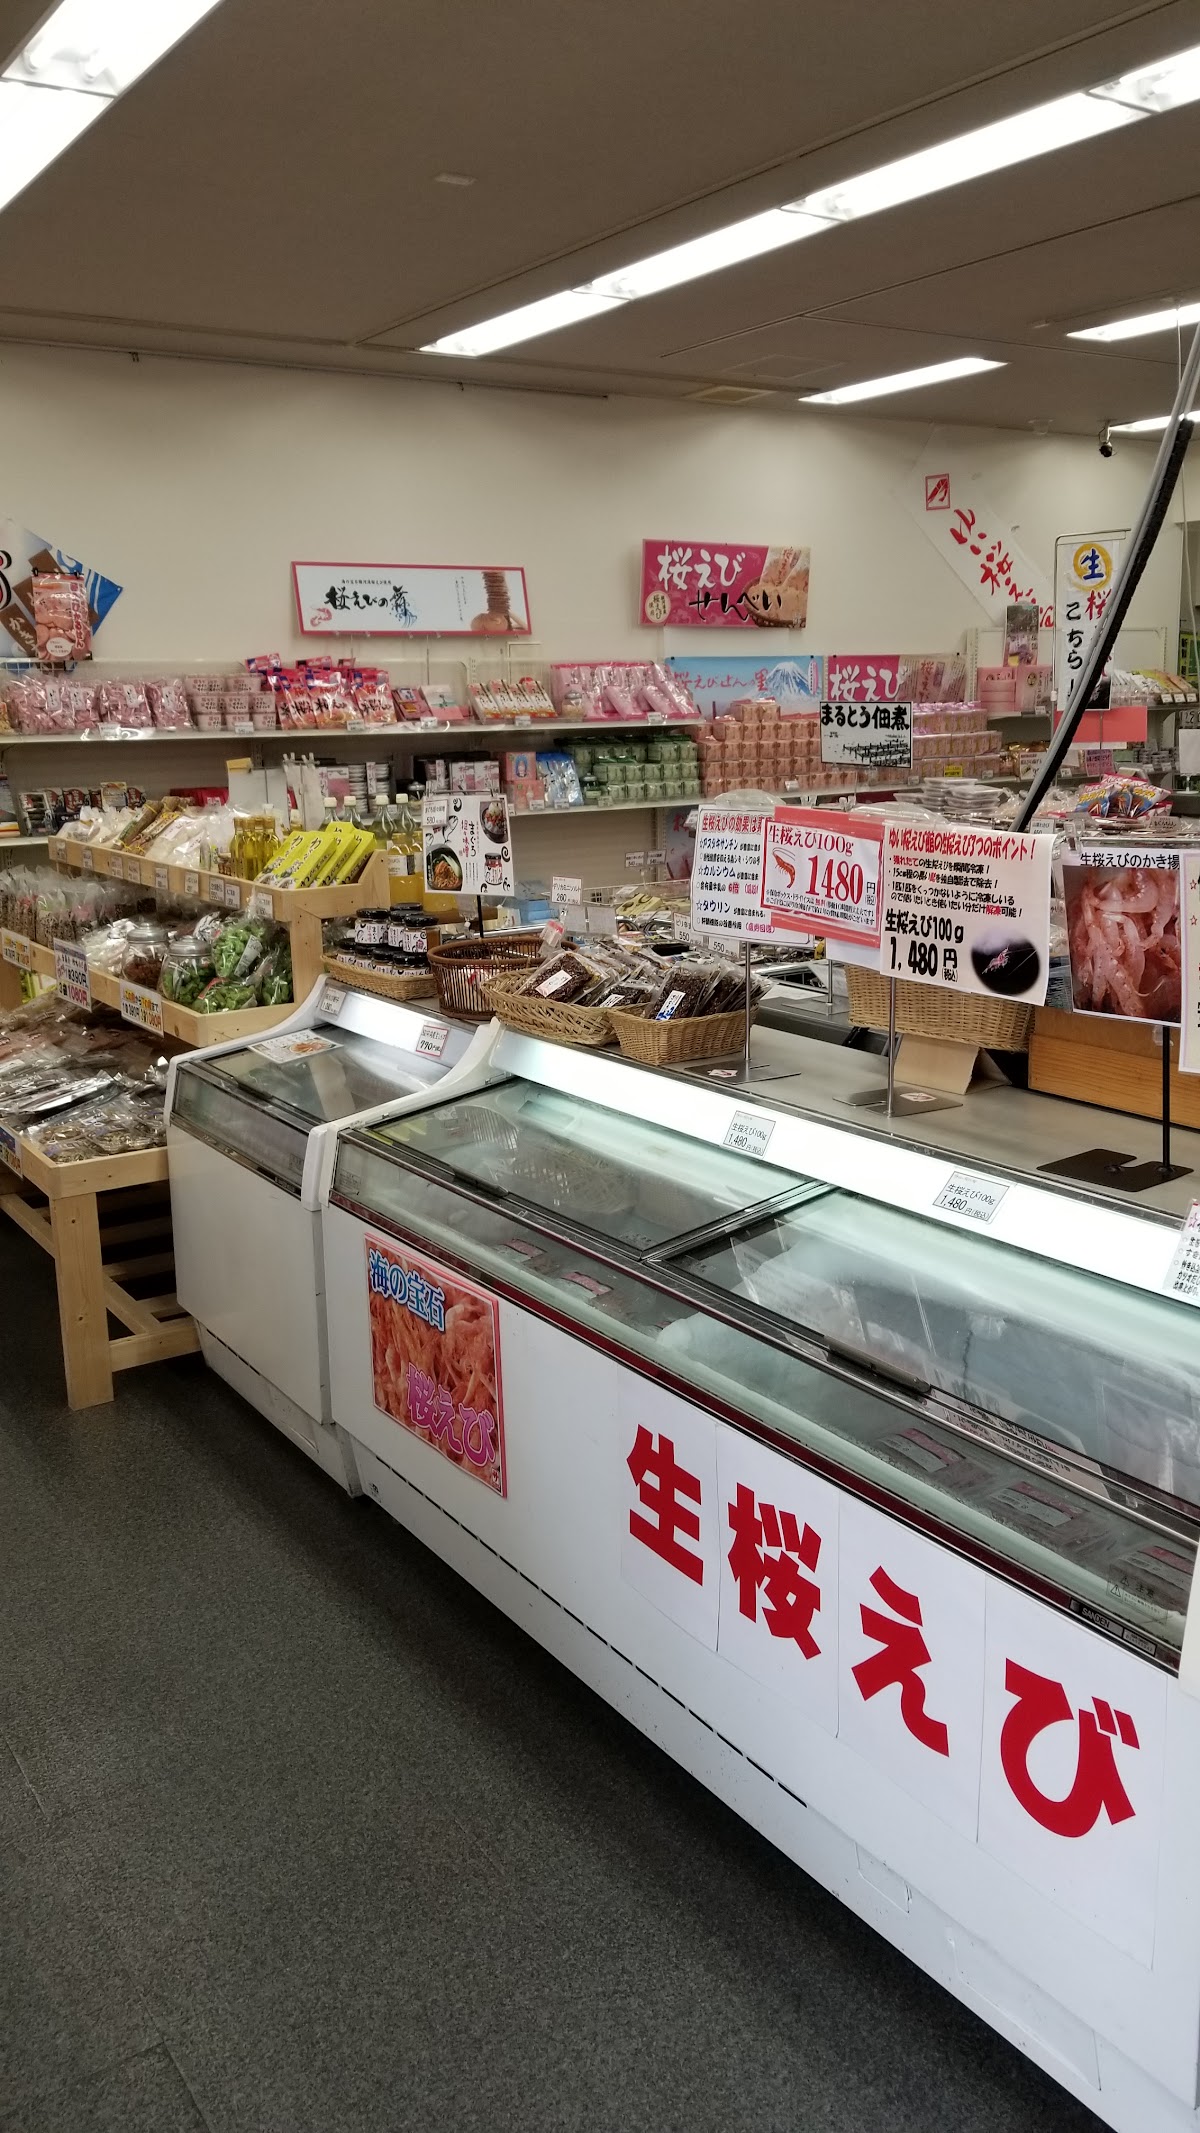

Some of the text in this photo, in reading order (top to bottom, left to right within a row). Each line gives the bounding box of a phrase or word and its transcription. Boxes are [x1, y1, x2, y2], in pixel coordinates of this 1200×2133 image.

[657, 544, 746, 591] 桜えび
[324, 585, 409, 613] 桜えびの舞
[689, 589, 782, 622] せんべい
[830, 664, 908, 701] 桜えび
[821, 705, 909, 730] まるとう佃煮
[768, 825, 854, 857] 生桜えび100g
[703, 865, 736, 878] カルシウム
[1080, 853, 1180, 870] 生桜えびのかき揚
[805, 855, 864, 905] 1480
[866, 882, 876, 894] 円
[703, 900, 730, 913] タウリン
[679, 931, 690, 942] 550
[713, 942, 725, 952] 550
[943, 948, 958, 968] 円
[942, 968, 958, 982] (税込)
[732, 1122, 767, 1141] 生桜えび100g
[940, 1194, 967, 1211] 1,480
[945, 1183, 996, 1206] 生桜えび100g
[369, 1248, 446, 1332] 海の宝石
[406, 1362, 495, 1467] 桜えび
[1081, 1607, 1110, 1628] SANDEN
[626, 1423, 1141, 1838] 生桜えび
